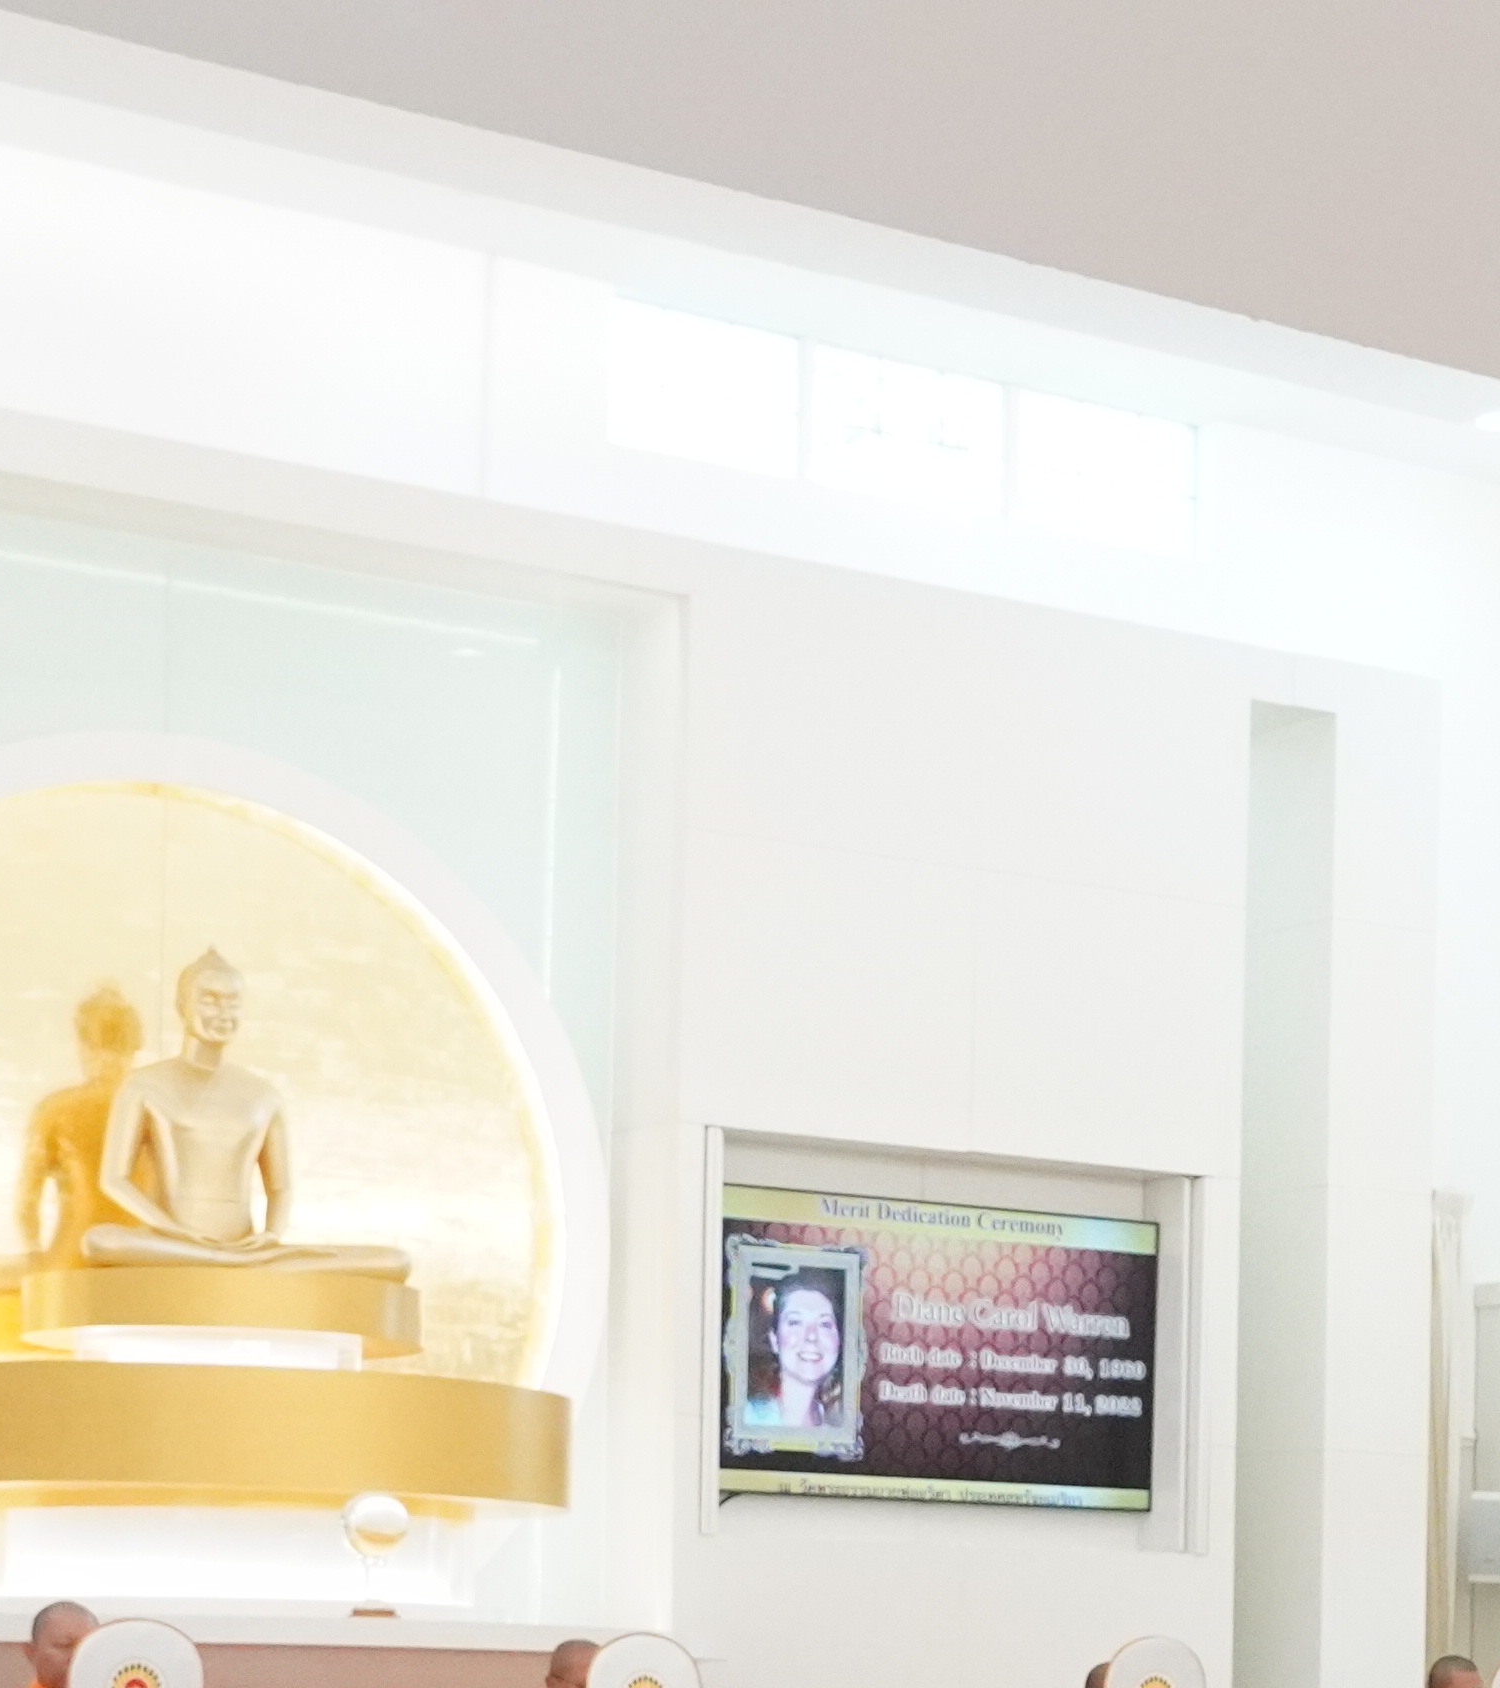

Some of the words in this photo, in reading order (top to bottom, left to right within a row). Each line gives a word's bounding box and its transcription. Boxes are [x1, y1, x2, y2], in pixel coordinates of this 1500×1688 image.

[820, 1197, 870, 1218] Merit
[878, 1203, 971, 1227] Dedication
[977, 1211, 1063, 1240] Ceremony
[892, 1291, 965, 1325] Diane
[968, 1299, 1038, 1331] Carol
[1042, 1302, 1130, 1339] Warren
[879, 1342, 925, 1365] Birth
[926, 1347, 963, 1368] date
[979, 1349, 1058, 1374] December
[878, 1380, 928, 1403] Death
[930, 1384, 966, 1405] date
[979, 1387, 1059, 1411] November
